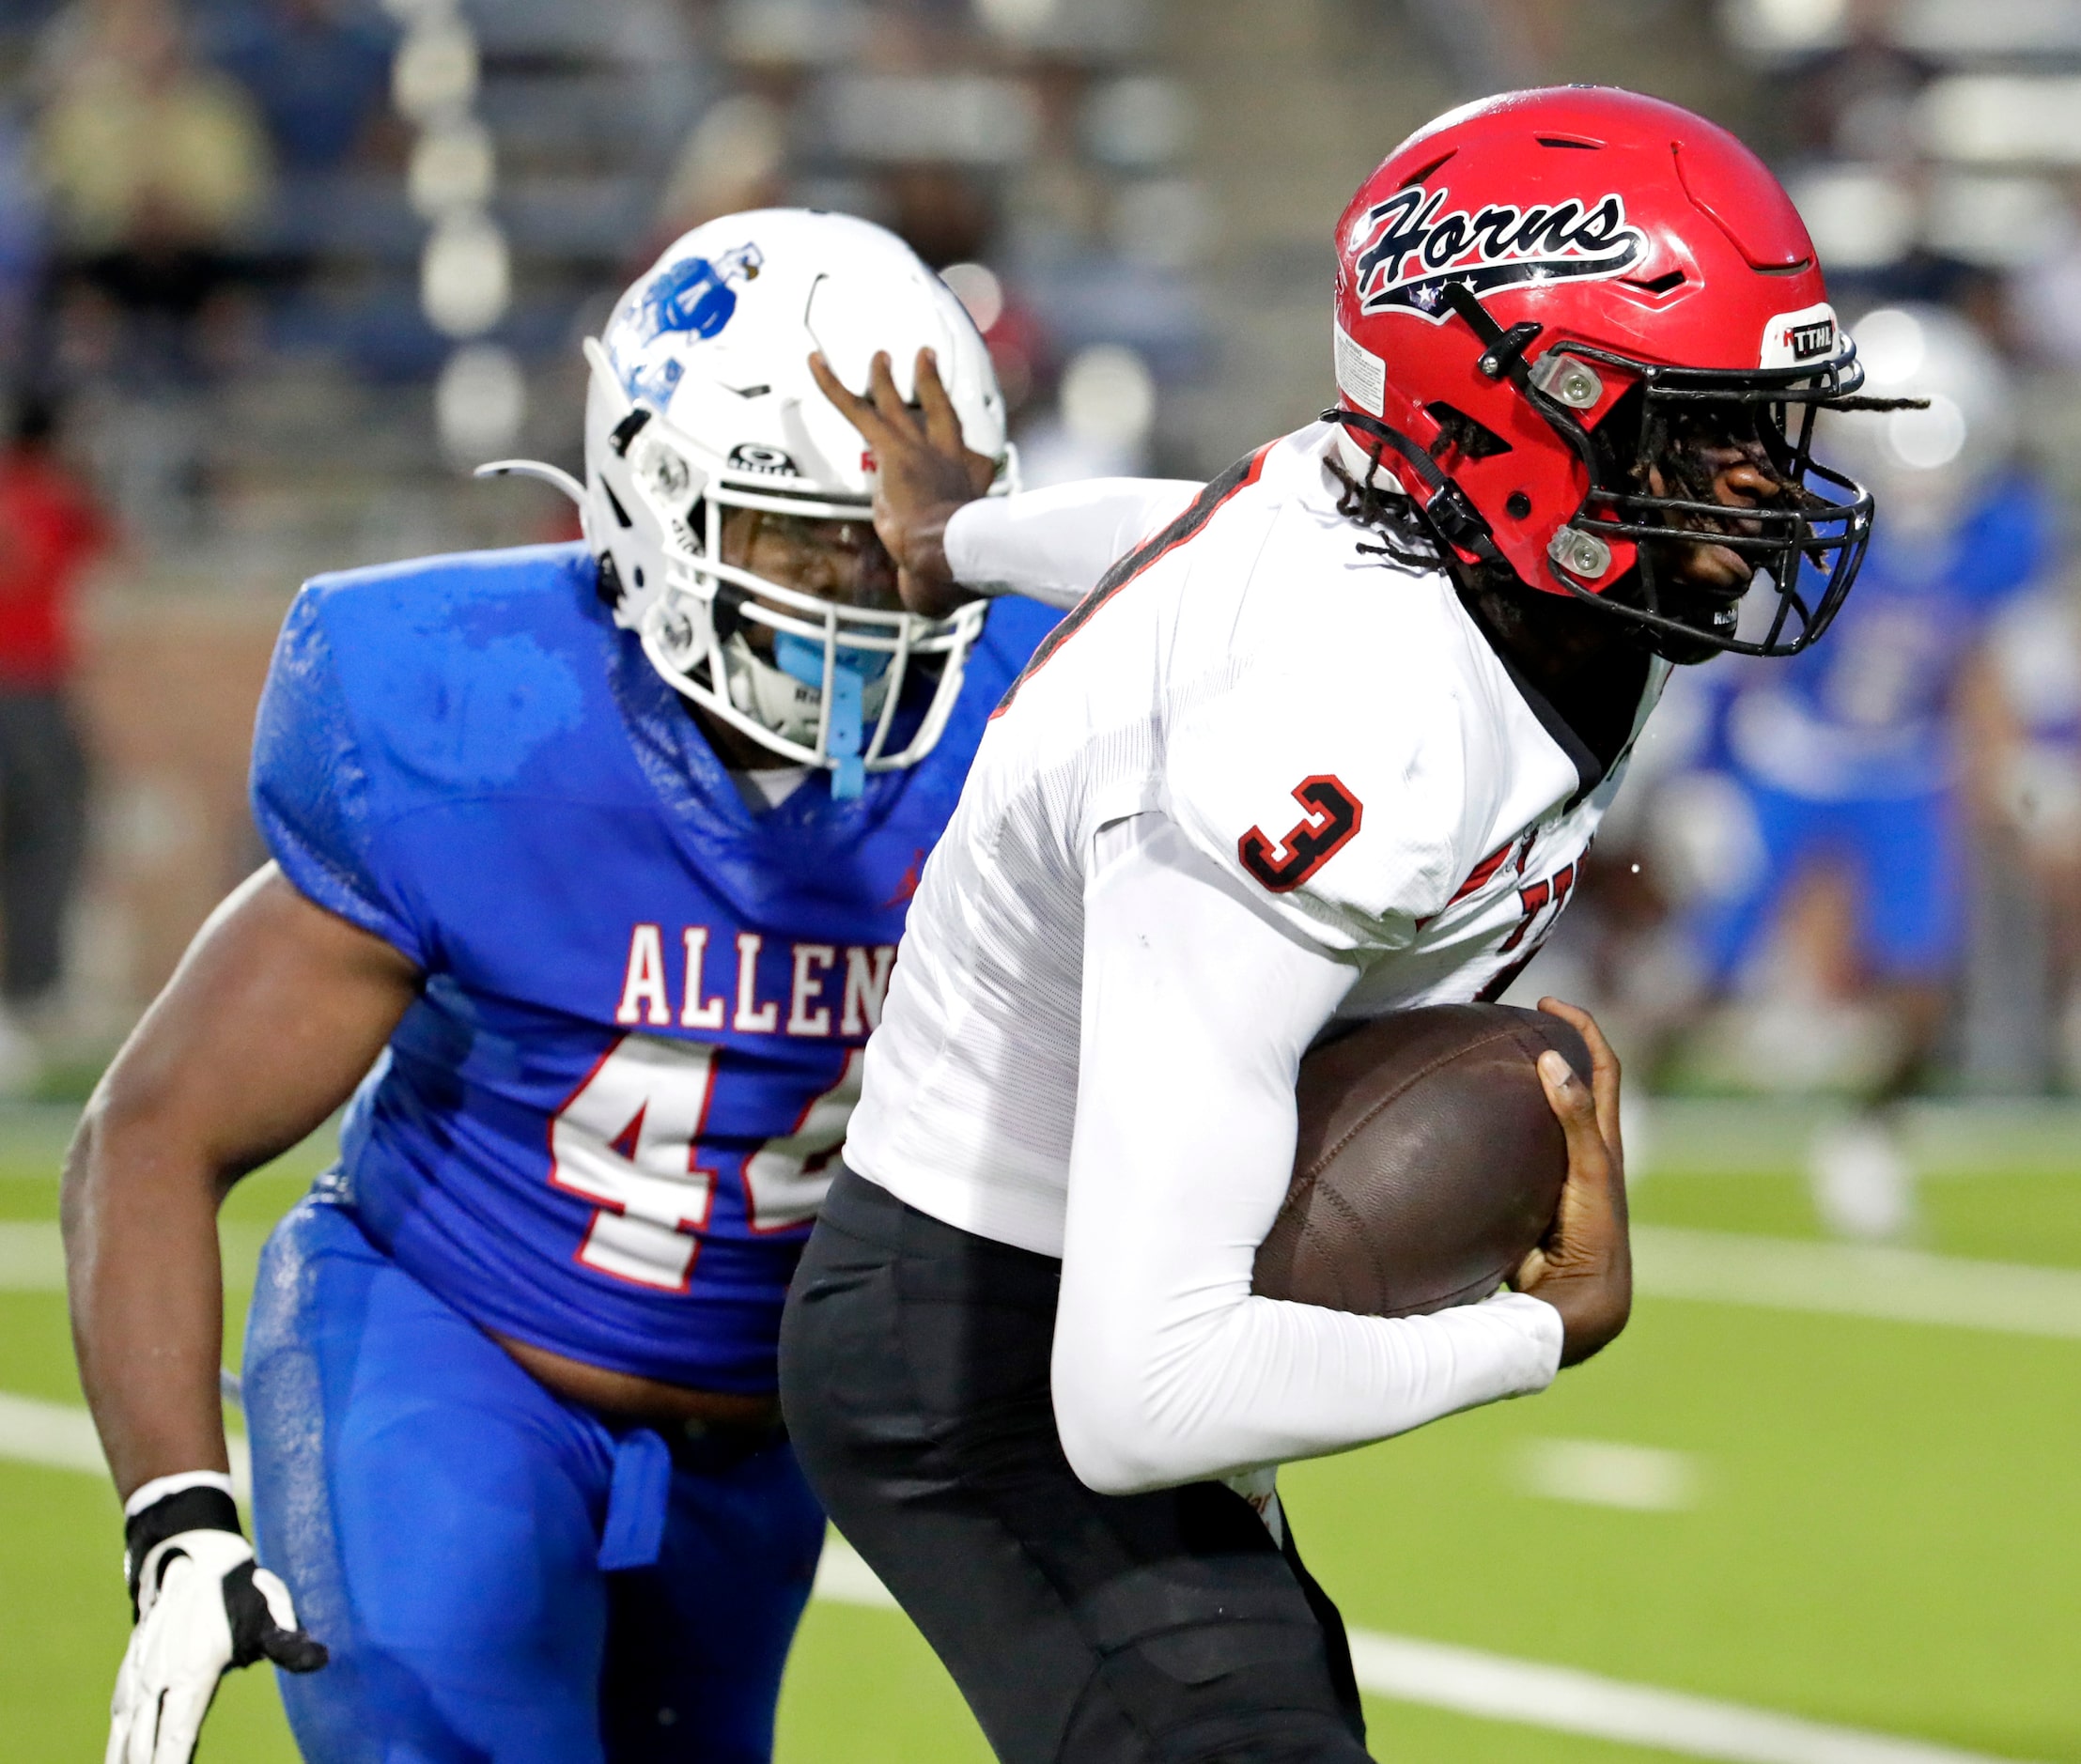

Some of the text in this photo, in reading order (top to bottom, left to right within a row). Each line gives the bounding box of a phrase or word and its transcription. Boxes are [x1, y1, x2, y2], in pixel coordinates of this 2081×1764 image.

[1347, 185, 1646, 302] Horns
[1794, 326, 1832, 352] TTHL
[1238, 774, 1363, 892] 3
[615, 922, 897, 1037] ALLEN
